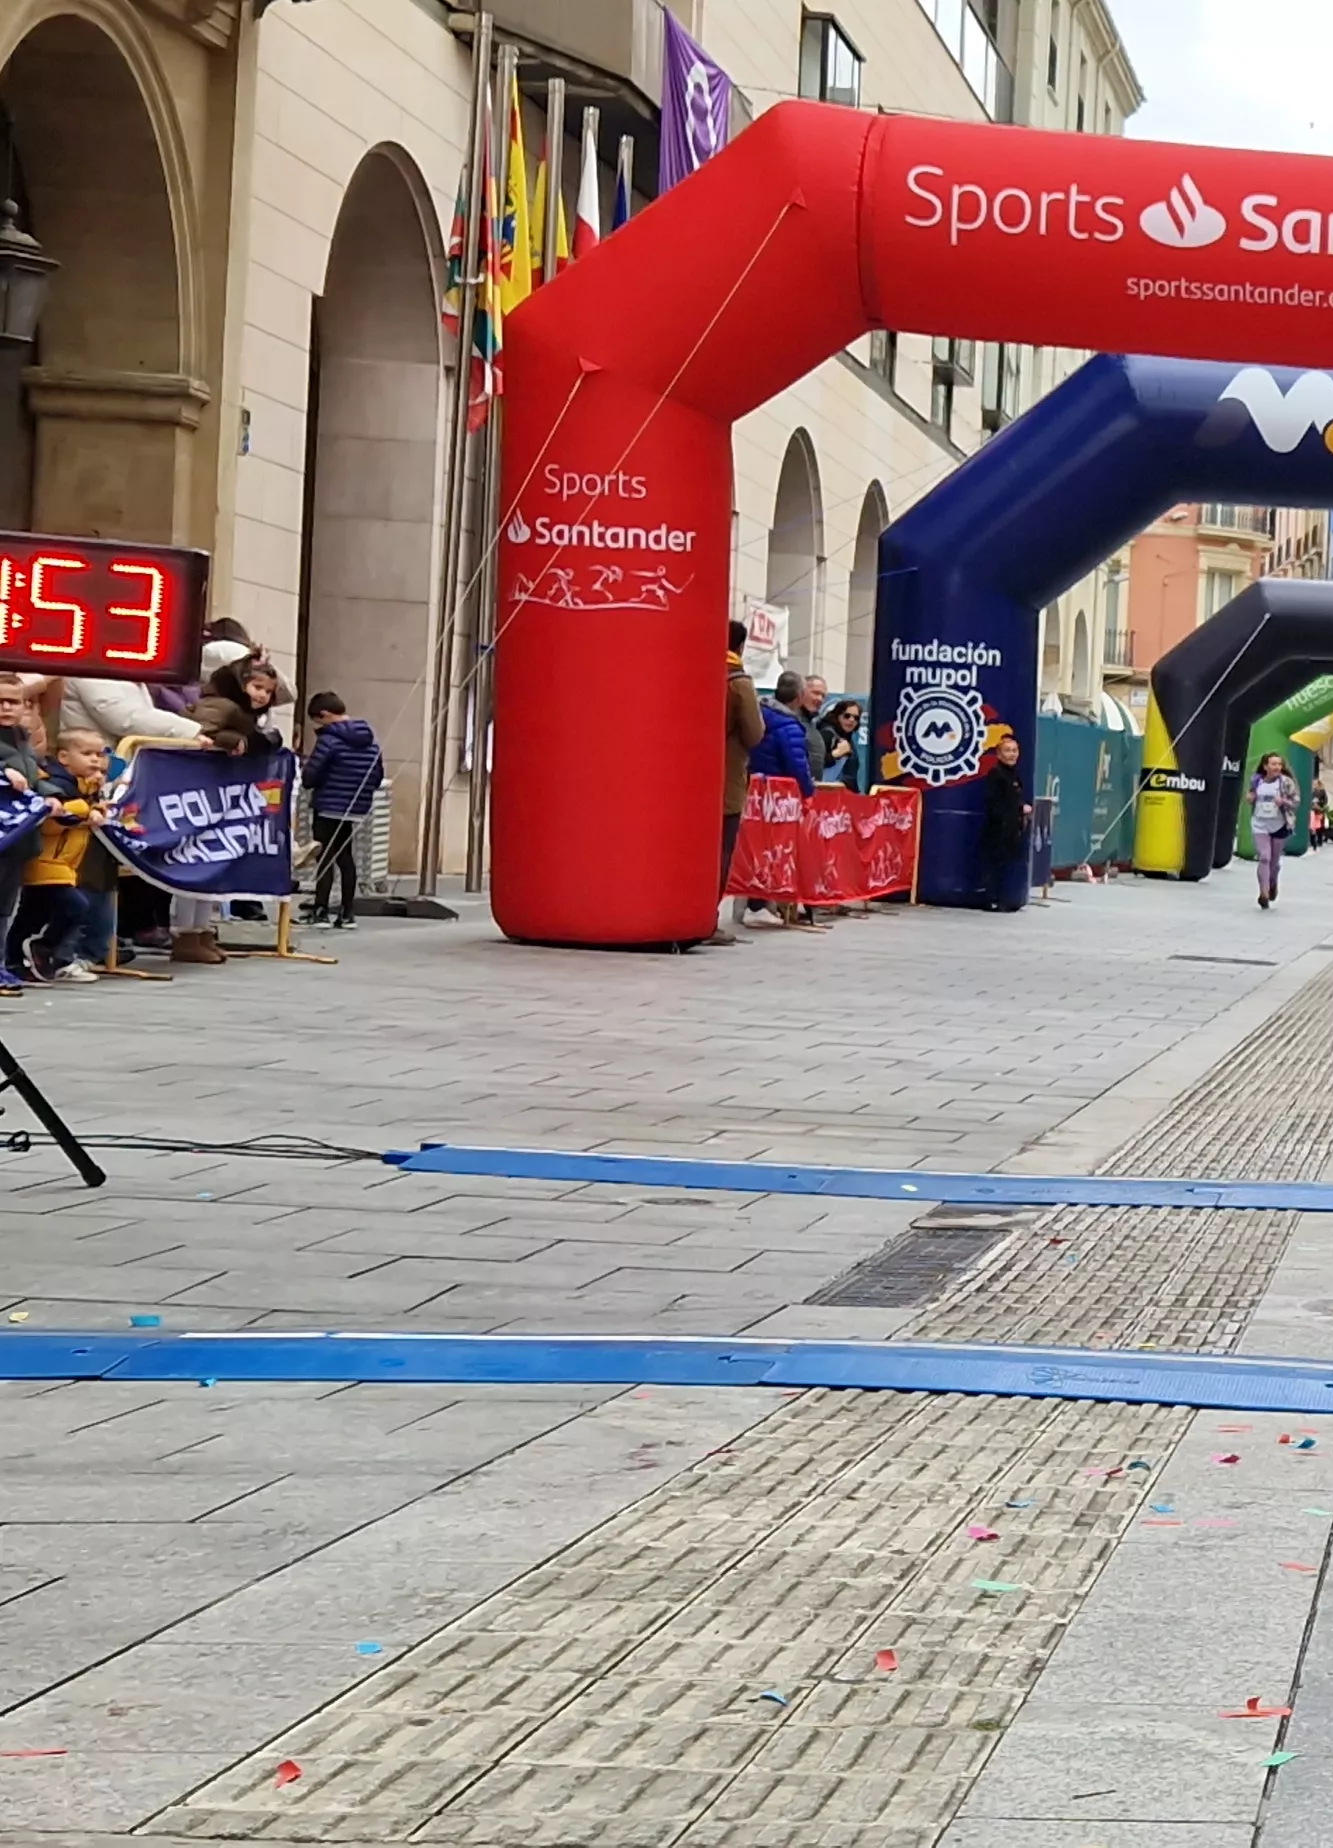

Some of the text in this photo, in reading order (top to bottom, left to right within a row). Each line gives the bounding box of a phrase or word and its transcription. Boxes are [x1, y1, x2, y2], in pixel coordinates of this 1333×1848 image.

[904, 164, 1126, 246] Sports
[543, 463, 648, 502] Sports
[534, 516, 697, 553] Santander
[890, 636, 1002, 668] fundación
[905, 664, 978, 689] mupol
[1149, 772, 1206, 792] embou
